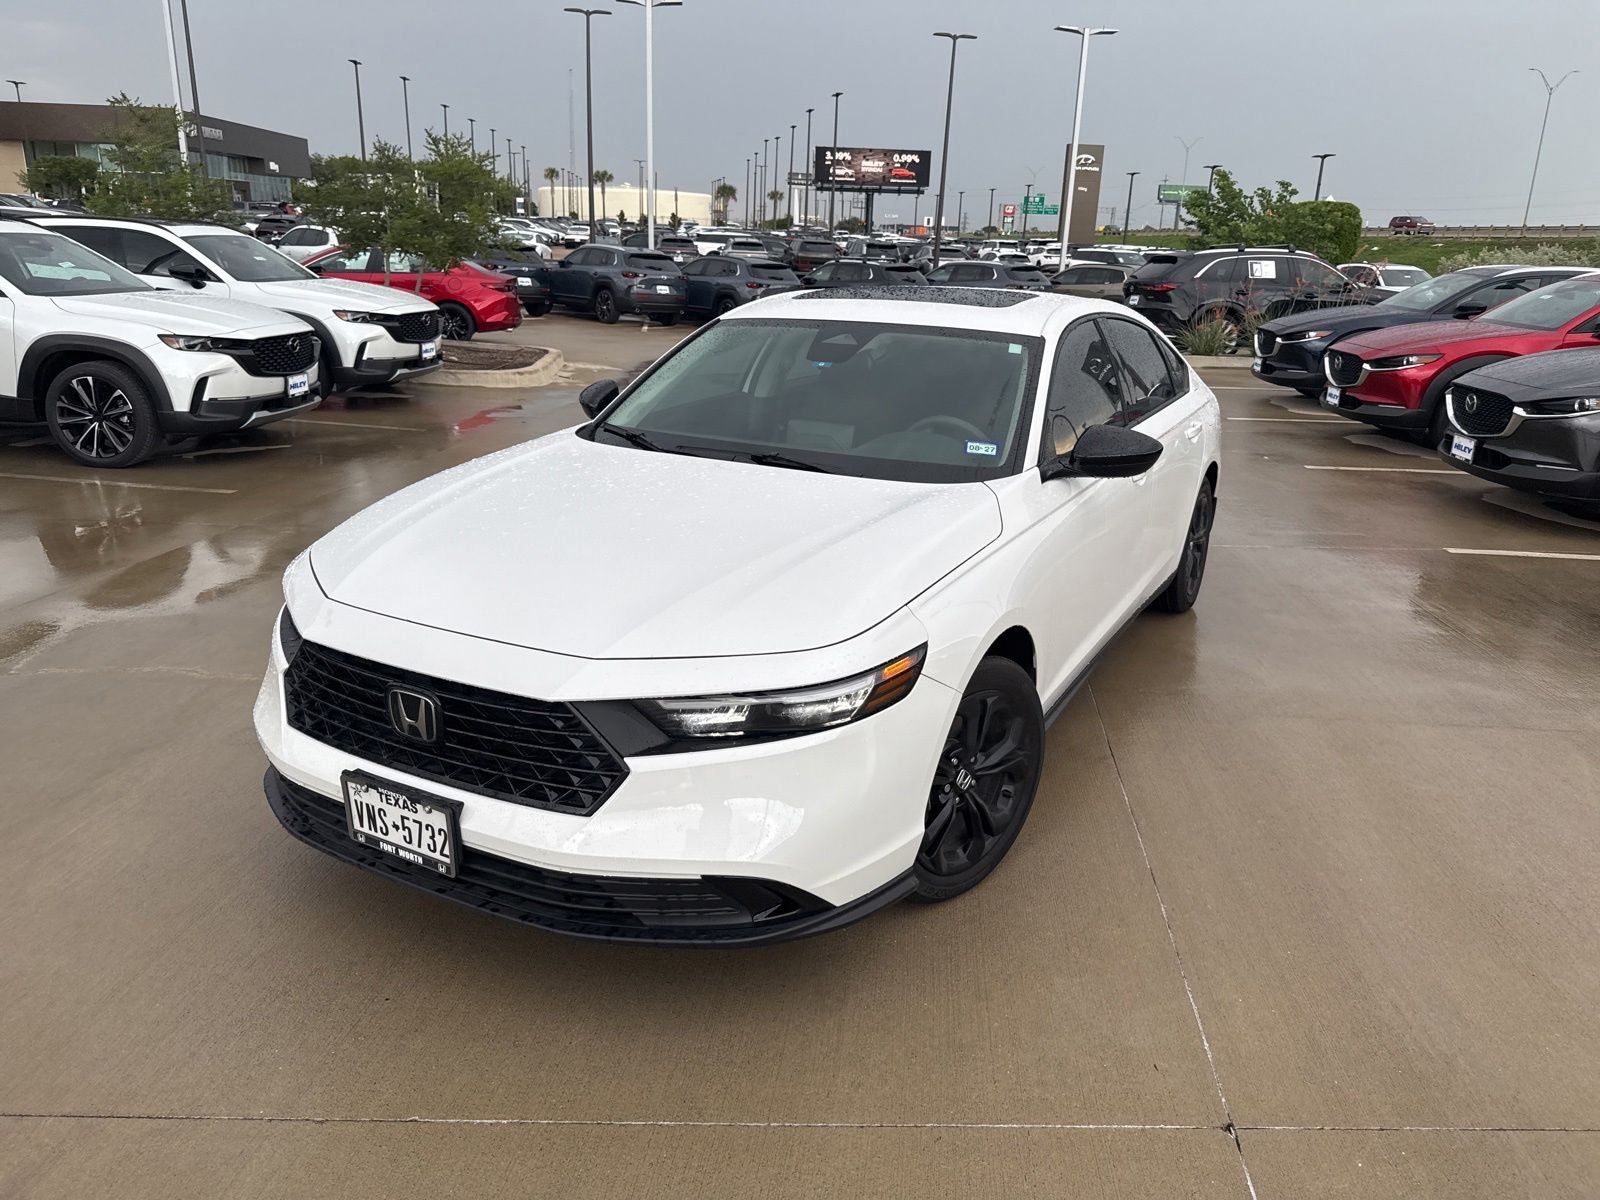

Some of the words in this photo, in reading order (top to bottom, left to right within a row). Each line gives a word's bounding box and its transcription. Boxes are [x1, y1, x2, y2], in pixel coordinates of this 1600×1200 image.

[290, 381, 306, 390] HILEY
[1454, 442, 1473, 454] HILEY
[377, 790, 418, 814] TEXAS
[380, 841, 396, 854] FORT
[398, 848, 423, 864] WORTH
